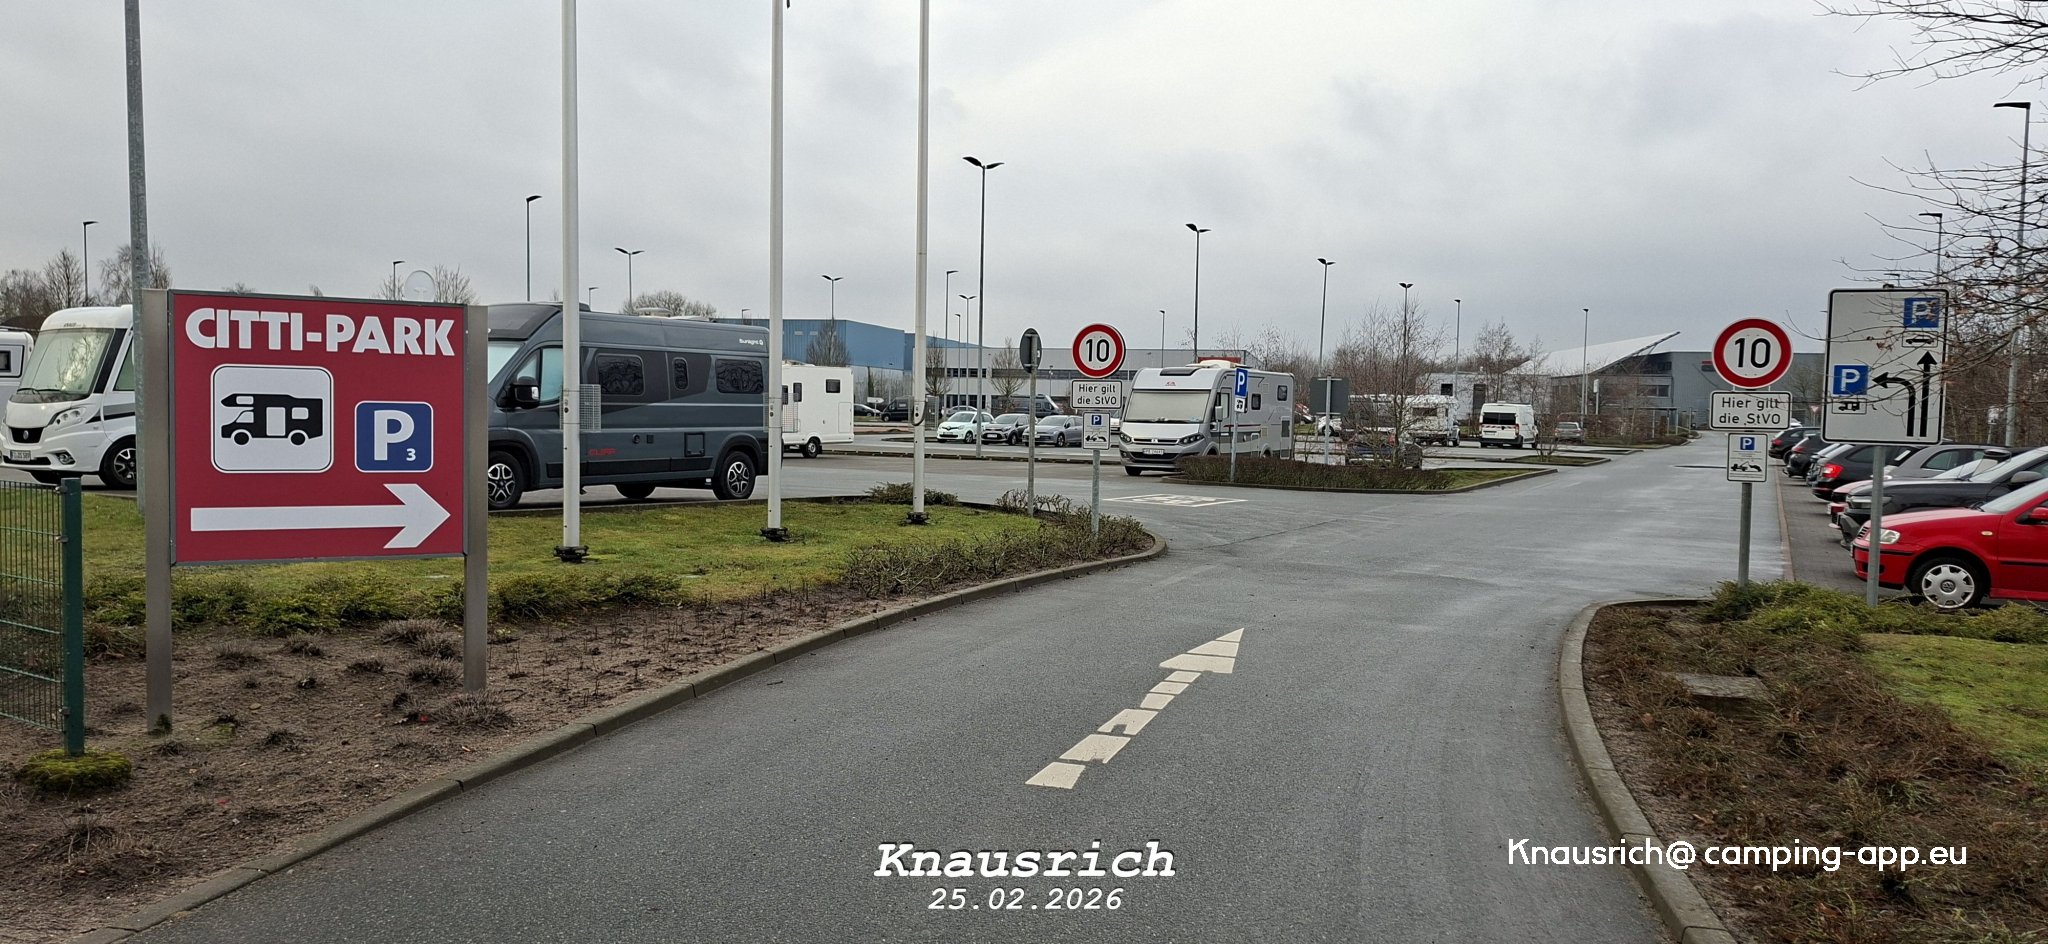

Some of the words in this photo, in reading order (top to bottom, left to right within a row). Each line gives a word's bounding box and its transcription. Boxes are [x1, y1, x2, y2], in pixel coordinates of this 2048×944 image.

[185, 307, 455, 356] CITTI-PARK
[1085, 338, 1110, 362] 10
[1734, 337, 1771, 369] 10
[1237, 371, 1245, 393] P
[1841, 368, 1861, 392] P
[1078, 384, 1098, 393] Hier
[1101, 384, 1116, 395] gilt
[1077, 396, 1091, 405] die
[1095, 396, 1117, 405] StVO
[1721, 397, 1751, 408] Hier
[1756, 397, 1780, 411] gilt
[1093, 415, 1100, 425] P
[1719, 413, 1740, 424] die
[1747, 413, 1781, 425] StVO
[373, 409, 415, 461] P
[1742, 438, 1753, 450] P
